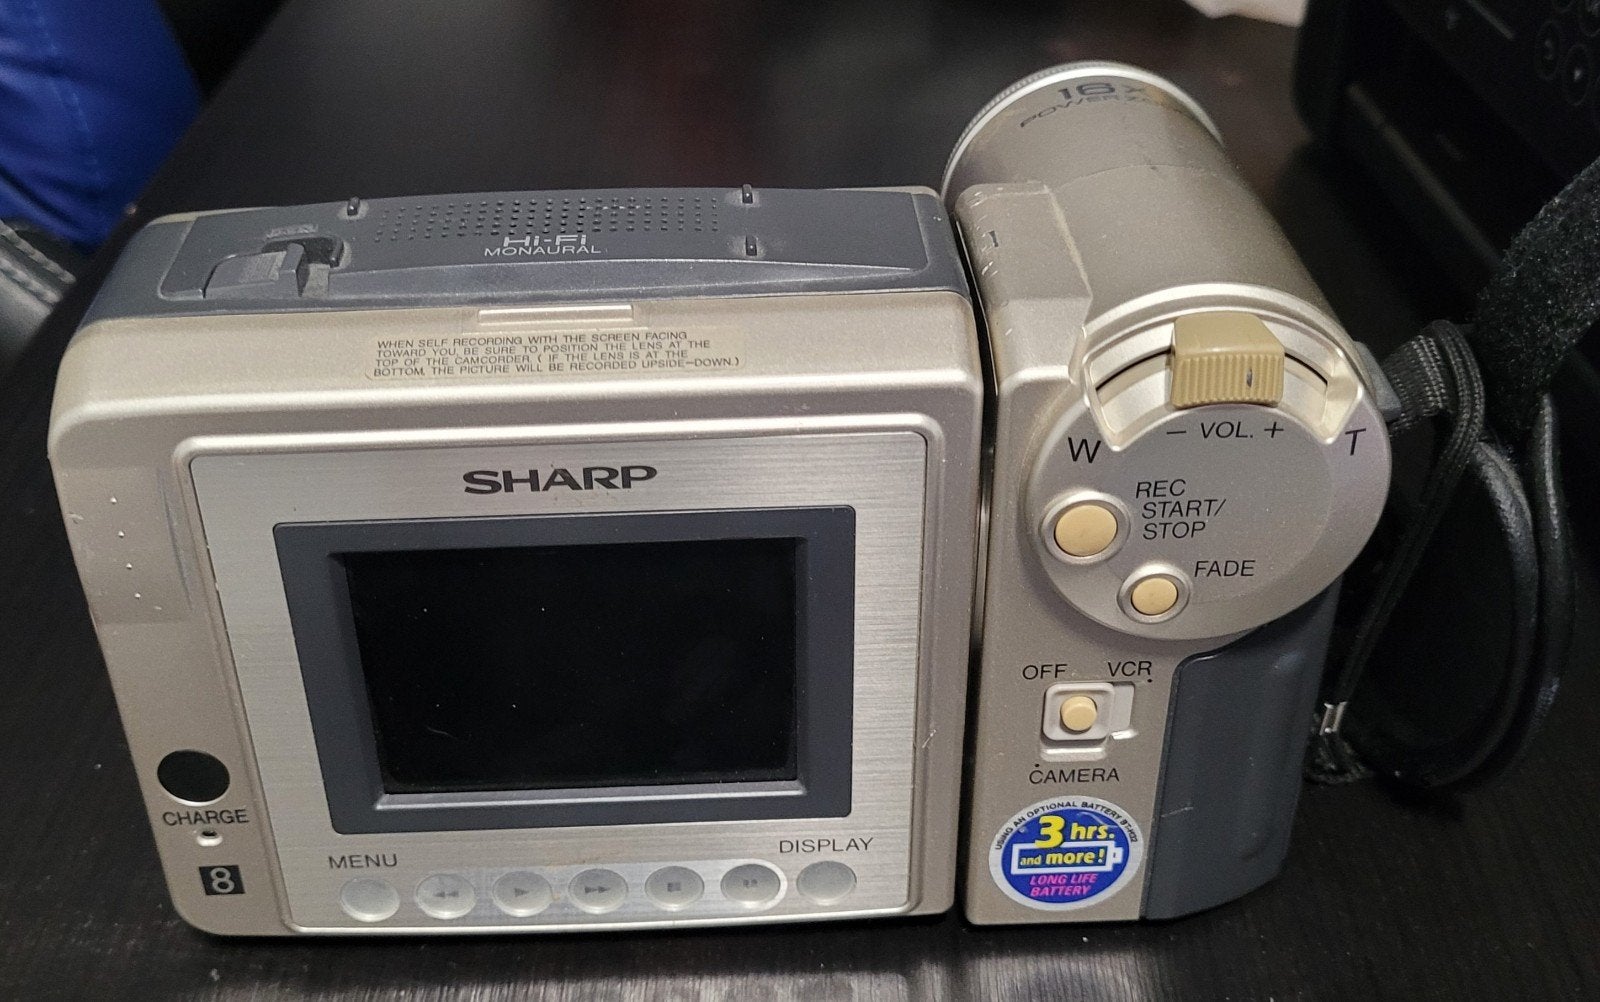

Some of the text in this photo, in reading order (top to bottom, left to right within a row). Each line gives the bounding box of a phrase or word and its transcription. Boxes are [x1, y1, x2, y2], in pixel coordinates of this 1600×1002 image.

[503, 234, 587, 247] Hi-Fi
[484, 245, 601, 257] MONAURAL
[377, 331, 688, 349] WHEN SELF RECORDING WITH THE SCREEN FACING
[377, 349, 426, 358] TOWARD
[464, 346, 481, 355] BE
[485, 345, 516, 355] SURE
[522, 345, 539, 354] TO
[543, 343, 599, 353] POSITION
[604, 343, 628, 351] THE
[632, 341, 663, 350] LENS
[669, 341, 682, 349] AT
[688, 340, 711, 348] THE
[376, 358, 399, 367] TOP
[404, 358, 420, 366] OF
[426, 357, 449, 366] THE
[549, 354, 559, 362] IF
[565, 353, 588, 362] THE
[593, 352, 624, 361] LENS
[629, 351, 640, 360] IS
[645, 351, 660, 359] AT
[665, 350, 689, 359] THE
[432, 366, 455, 375] THE
[459, 364, 510, 374] PICTURE
[516, 363, 543, 372] WILL
[549, 362, 564, 371] BE
[570, 360, 637, 371] RECORDED
[1200, 421, 1254, 439] VOL.
[1067, 437, 1101, 464] W
[1345, 428, 1367, 456] T
[462, 465, 658, 495] SHARP
[1135, 479, 1187, 499] REC
[1141, 498, 1227, 519] START/
[1142, 521, 1206, 540] STOP
[1194, 560, 1256, 578] FADE
[1022, 663, 1068, 680] OFF
[1107, 660, 1153, 677] VCR
[1028, 767, 1120, 785] CAMERA
[162, 808, 250, 827] CHARGE
[994, 827, 1014, 851] USING
[1013, 816, 1027, 828] AN
[1026, 800, 1078, 818] OPTIONAL
[1080, 801, 1122, 820] BATTERY
[1034, 814, 1115, 849] 3 hrs.
[779, 836, 874, 854] DISPLAY
[327, 853, 399, 870] MENU
[1019, 853, 1043, 866] and
[210, 867, 236, 895] 8
[1029, 872, 1099, 886] LONG LIFE
[1030, 885, 1093, 898] BATTERY
